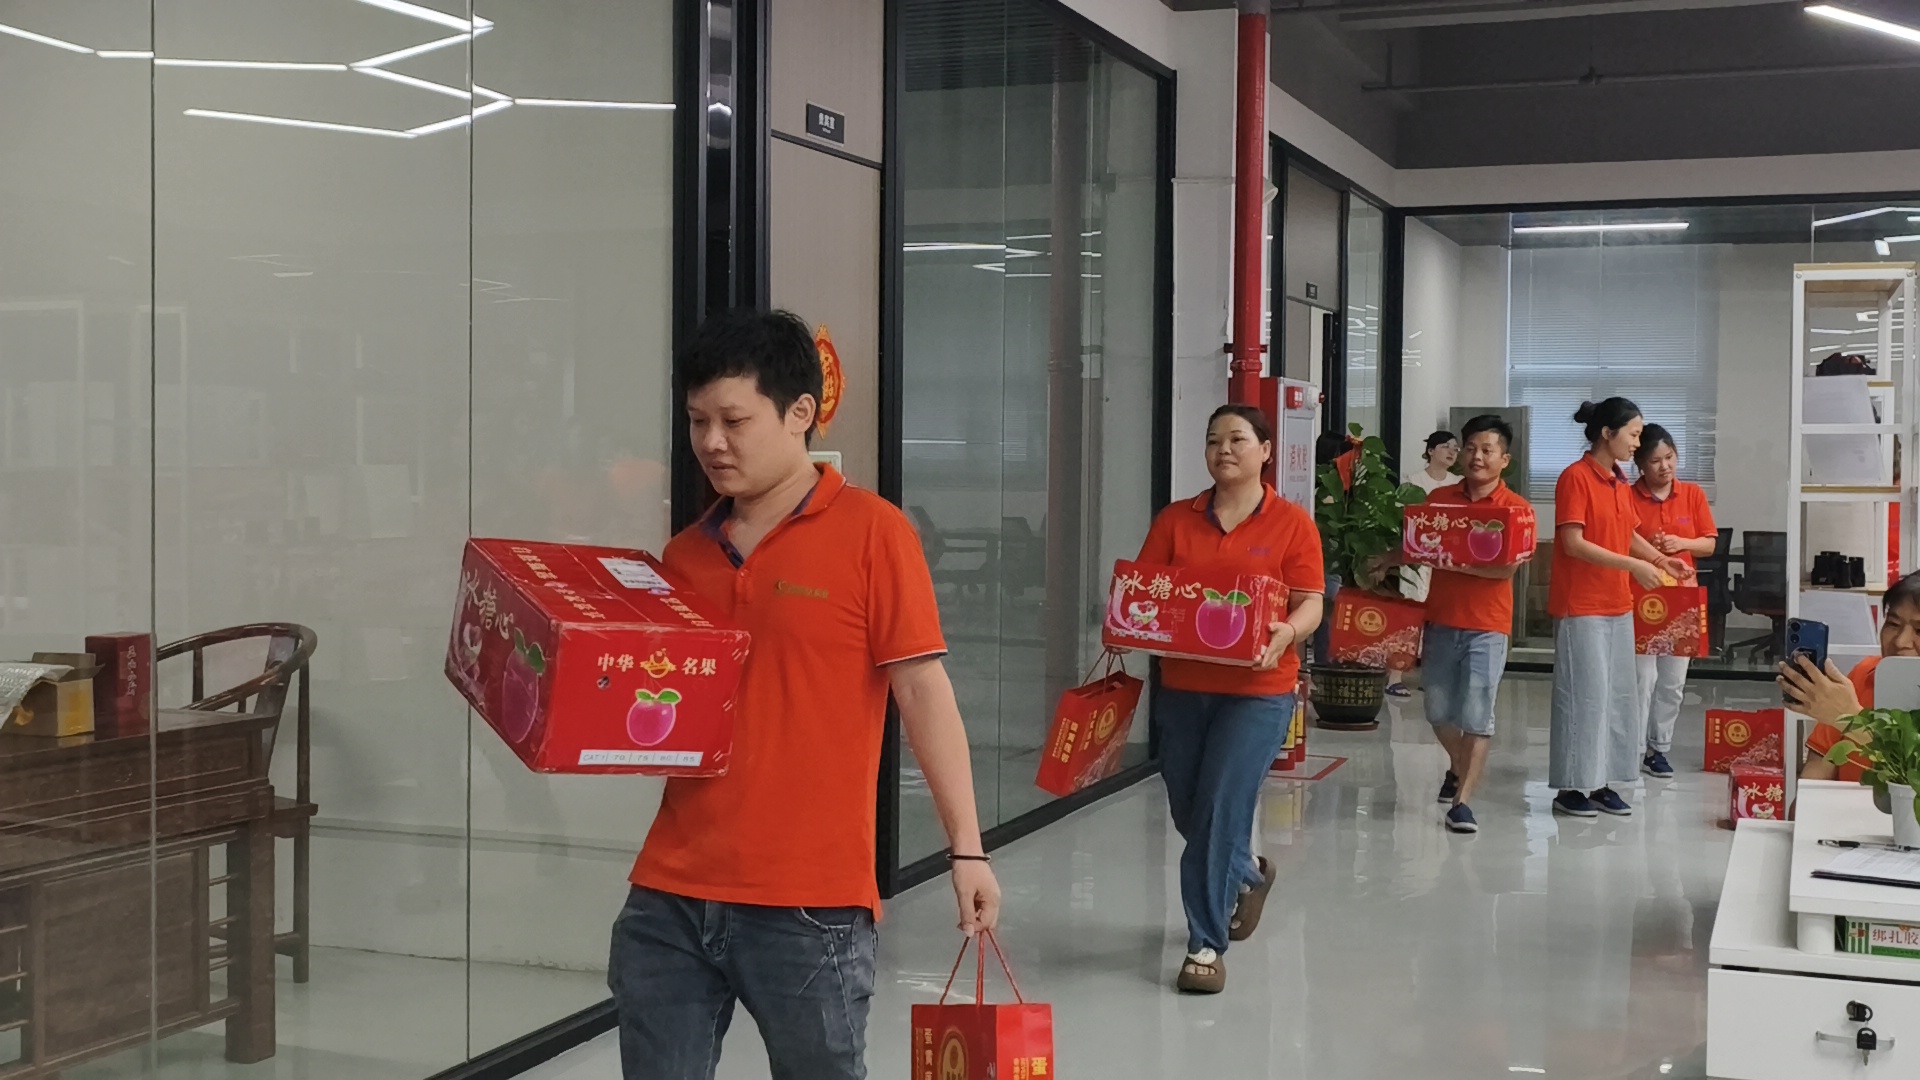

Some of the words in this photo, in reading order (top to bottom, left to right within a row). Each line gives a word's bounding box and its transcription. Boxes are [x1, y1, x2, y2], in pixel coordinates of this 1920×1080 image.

[1414, 511, 1469, 532] 冰糖心
[1119, 570, 1202, 600] 冰糖心
[466, 568, 514, 641] 冰糖心
[597, 653, 634, 673] 中华
[681, 657, 717, 676] 名果
[1742, 781, 1784, 801] 冰糖
[1872, 929, 1920, 945] 绑扎胶
